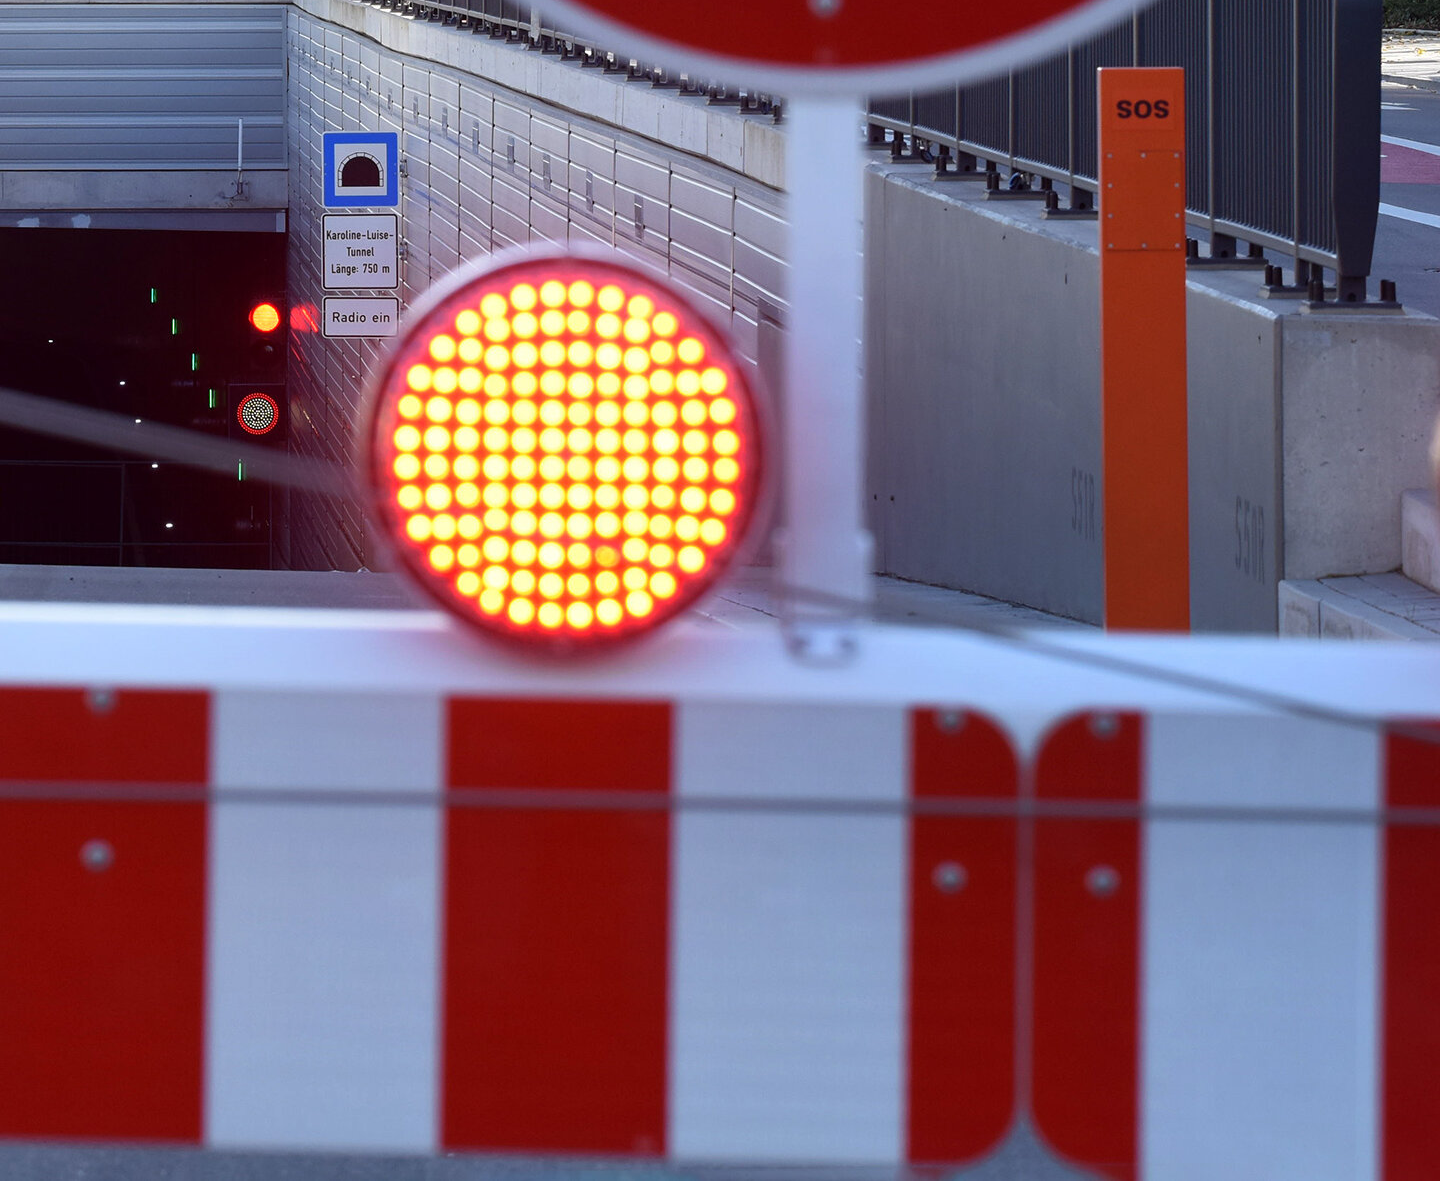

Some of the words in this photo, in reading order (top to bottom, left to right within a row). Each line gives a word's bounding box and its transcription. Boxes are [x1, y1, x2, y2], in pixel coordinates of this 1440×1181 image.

[1116, 99, 1169, 119] SOS
[326, 230, 394, 240] Karoline-Luise-
[346, 246, 374, 257] Tunnel
[331, 263, 358, 276] Länge:
[363, 263, 378, 274] 750
[382, 266, 390, 274] m
[332, 311, 366, 323] Radio
[372, 311, 390, 323] ein
